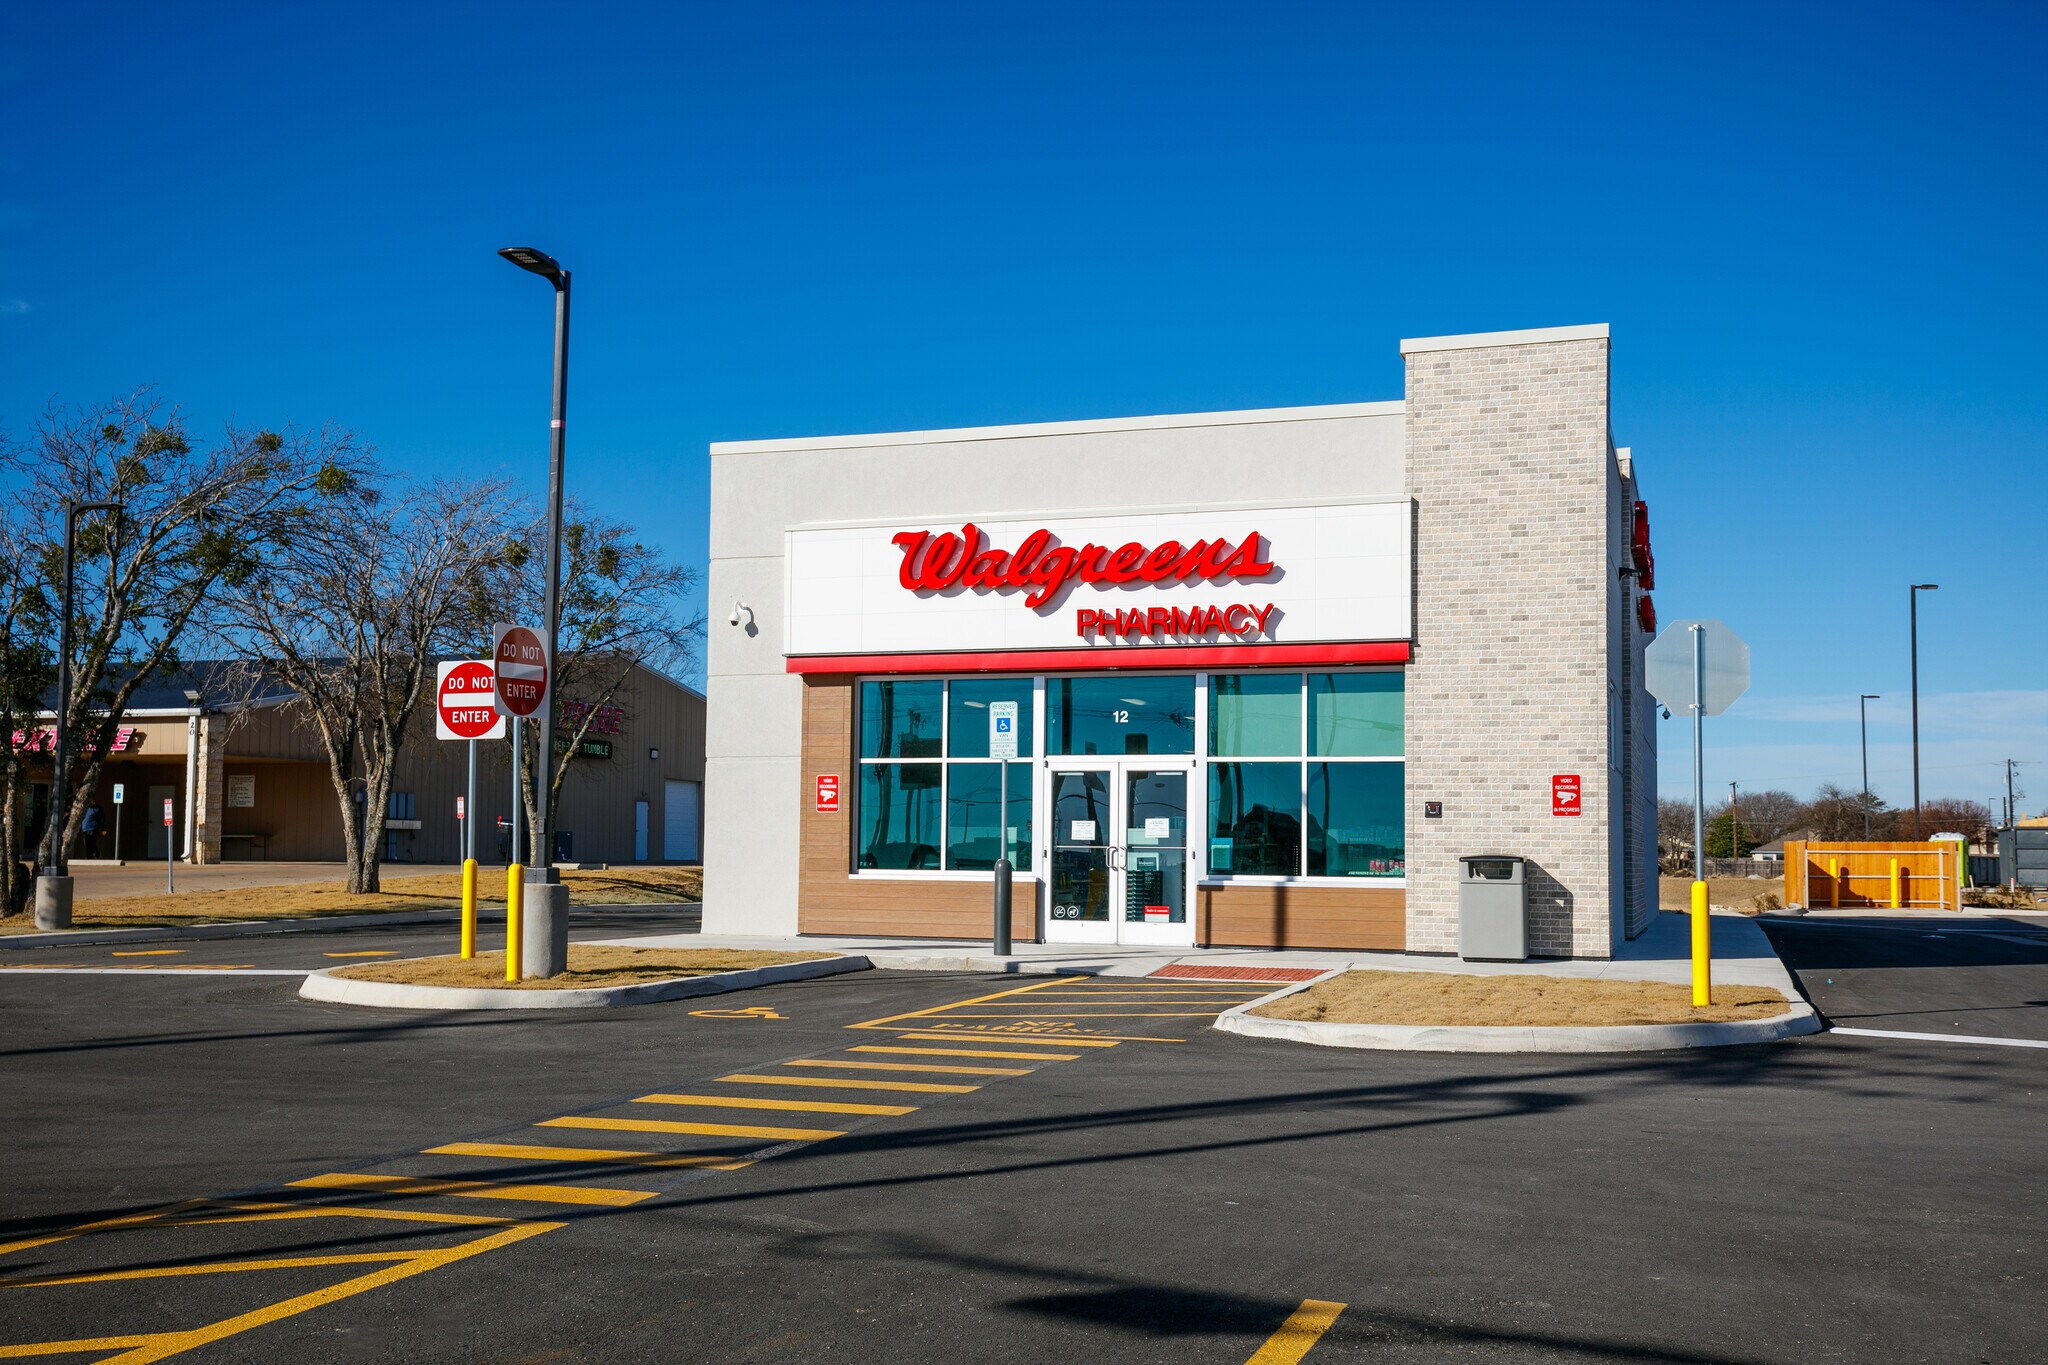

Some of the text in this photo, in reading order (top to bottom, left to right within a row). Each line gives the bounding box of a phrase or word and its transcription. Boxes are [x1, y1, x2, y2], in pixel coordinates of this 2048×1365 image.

[892, 522, 1274, 608] Walgreens
[1077, 602, 1274, 637] PHARMACY
[503, 643, 540, 660] DO NOT
[448, 677, 465, 690] DO
[506, 683, 536, 699] ENTER
[452, 710, 490, 723] ENTER
[1112, 710, 1129, 723] 12
[583, 742, 609, 756] TUMBLE
